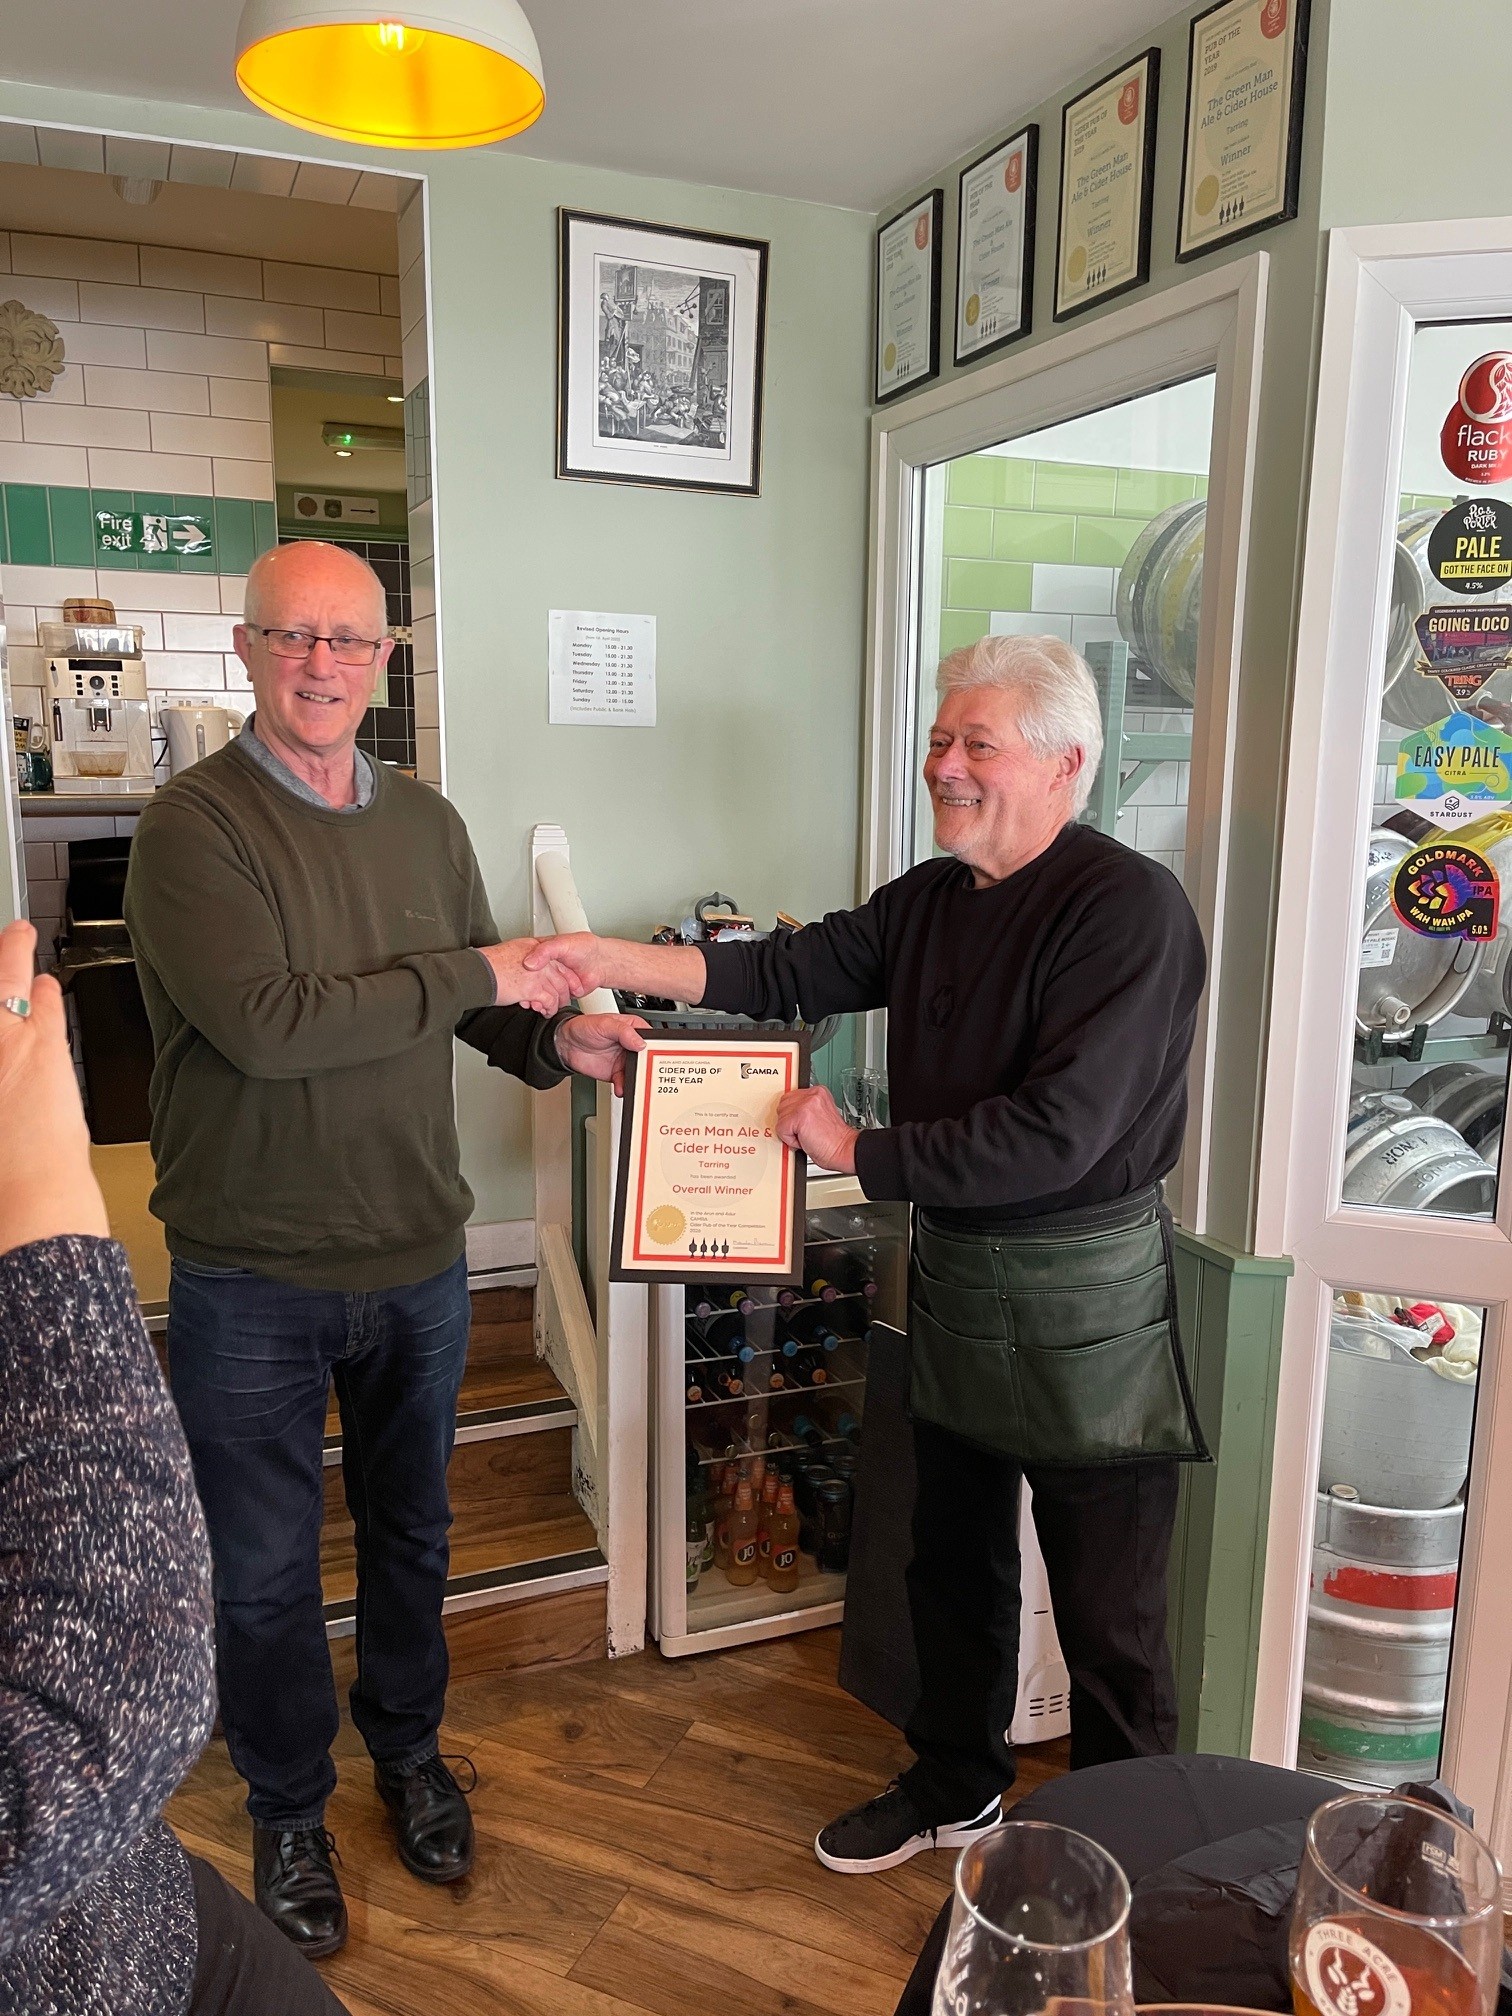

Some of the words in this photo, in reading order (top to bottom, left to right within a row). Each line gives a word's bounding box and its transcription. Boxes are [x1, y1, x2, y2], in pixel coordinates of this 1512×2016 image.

[1228, 27, 1241, 40] THE
[1208, 97, 1223, 111] The
[1225, 82, 1251, 101] Green
[1254, 69, 1273, 87] Man
[1201, 115, 1214, 129] Ale
[1217, 108, 1222, 120] &
[1225, 98, 1247, 115] Cider
[1250, 82, 1278, 103] House
[1221, 145, 1251, 166] Winner
[1091, 163, 1111, 180] Green
[1113, 153, 1128, 167] Man
[1110, 163, 1132, 182] House
[1468, 450, 1508, 461] RUBY
[100, 518, 132, 531] Fire
[1463, 515, 1498, 530] PORTER
[102, 533, 132, 546] exit
[1456, 536, 1502, 558] PALE
[1444, 565, 1459, 574] GOT
[1461, 565, 1475, 574] THE
[1477, 564, 1495, 573] FACE
[1497, 564, 1508, 573] ON
[1429, 618, 1470, 632] GOING
[1474, 616, 1510, 631] LOCO
[1445, 674, 1482, 687] TRING
[1415, 746, 1456, 767] EASY
[1461, 747, 1500, 768] PALE
[1408, 850, 1484, 877] GOLDMARK
[1473, 886, 1492, 896] IPA
[1410, 906, 1431, 924] WAH
[1432, 918, 1456, 926] WAH
[1456, 909, 1474, 923] IPA
[660, 1125, 700, 1136] Green
[705, 1126, 733, 1136] Man
[737, 1127, 759, 1137] Ale
[764, 1128, 772, 1137] &
[674, 1142, 709, 1154] Cider
[714, 1144, 756, 1154] House
[698, 1161, 730, 1169] Tarring
[672, 1184, 711, 1194] Overall
[715, 1186, 753, 1195] Winner
[1318, 1929, 1354, 1944] THREE
[1362, 1946, 1398, 1982] ACRE
